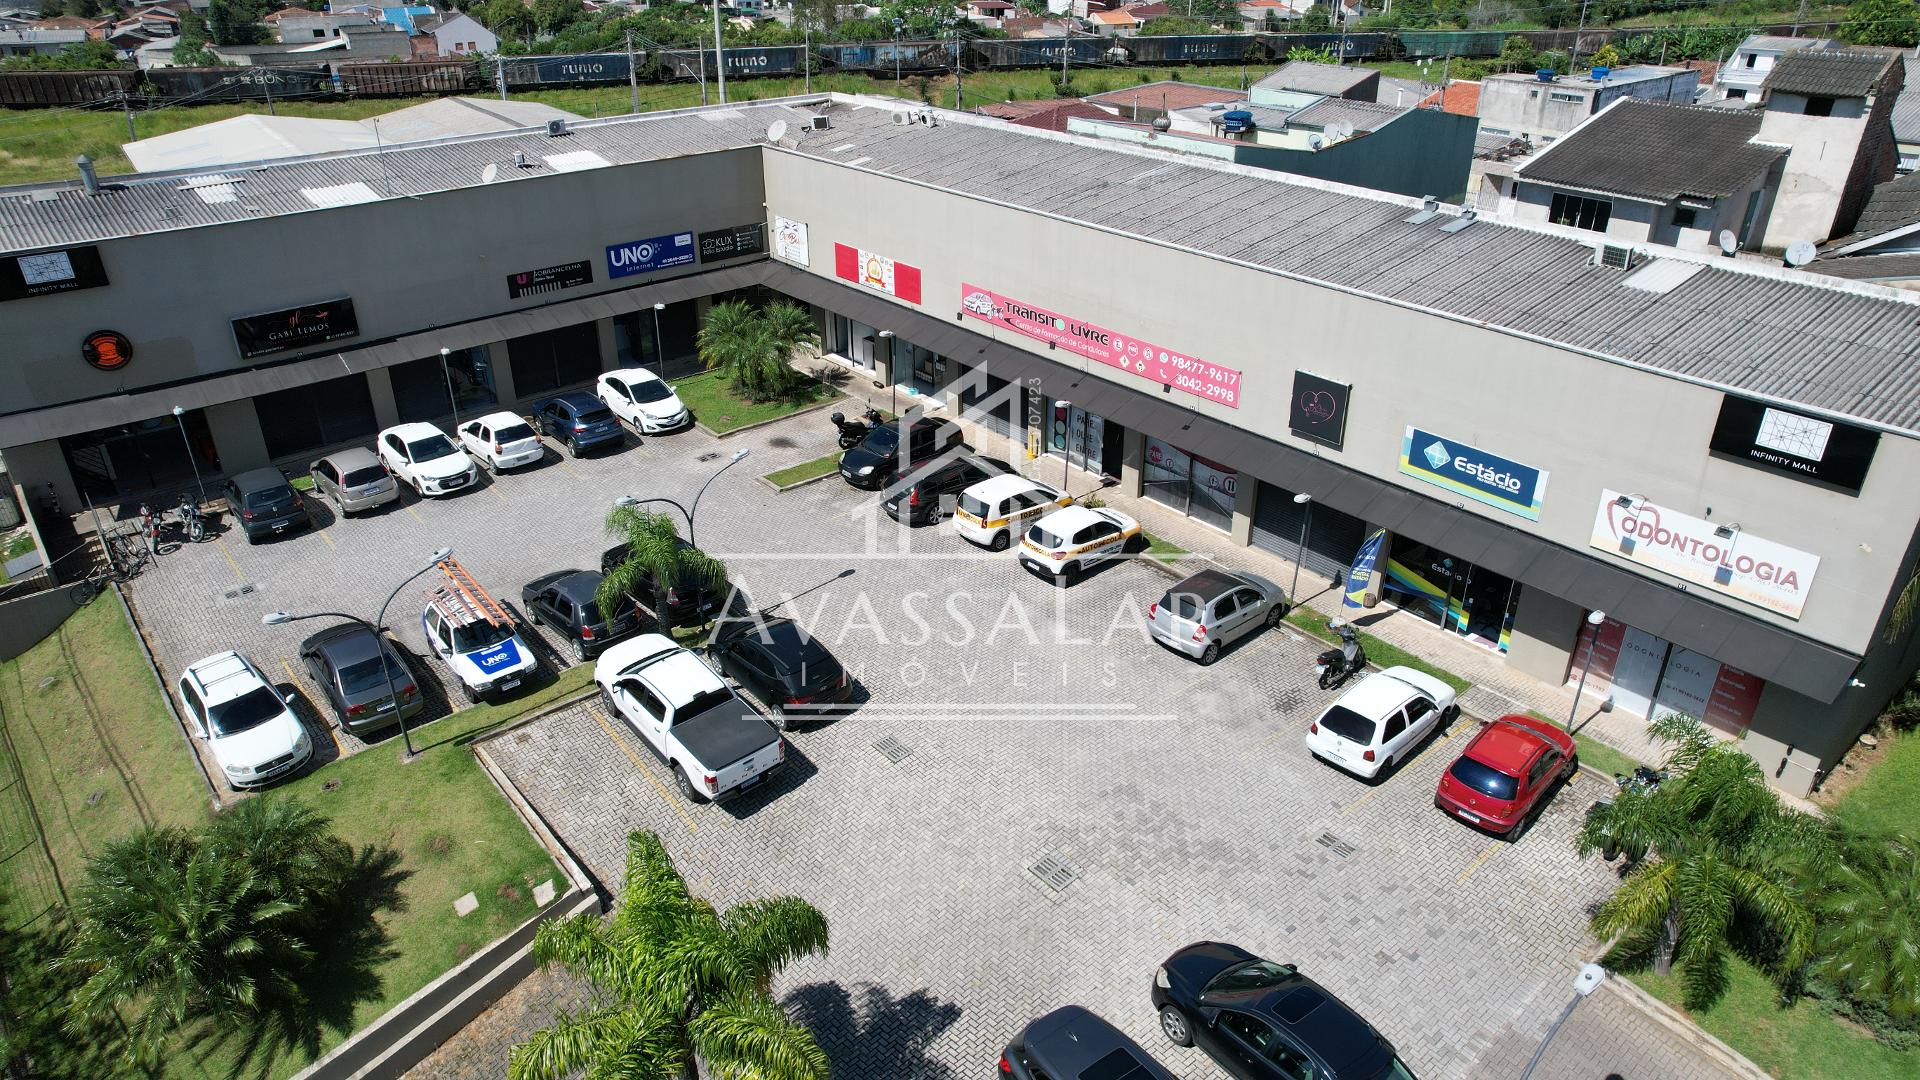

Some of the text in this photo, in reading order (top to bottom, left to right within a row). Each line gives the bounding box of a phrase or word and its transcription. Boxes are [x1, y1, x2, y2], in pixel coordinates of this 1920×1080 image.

[561, 63, 603, 75] rumo
[726, 55, 768, 67] rumo
[610, 243, 653, 267] UNO
[297, 322, 330, 336] LEMOS
[1175, 374, 1234, 402] 3042-2998
[1453, 456, 1521, 490] Estácio
[1750, 449, 1819, 474] INFINITY MALL
[1621, 516, 1800, 591] ODONTOLOGIA
[481, 653, 507, 666] UNO
